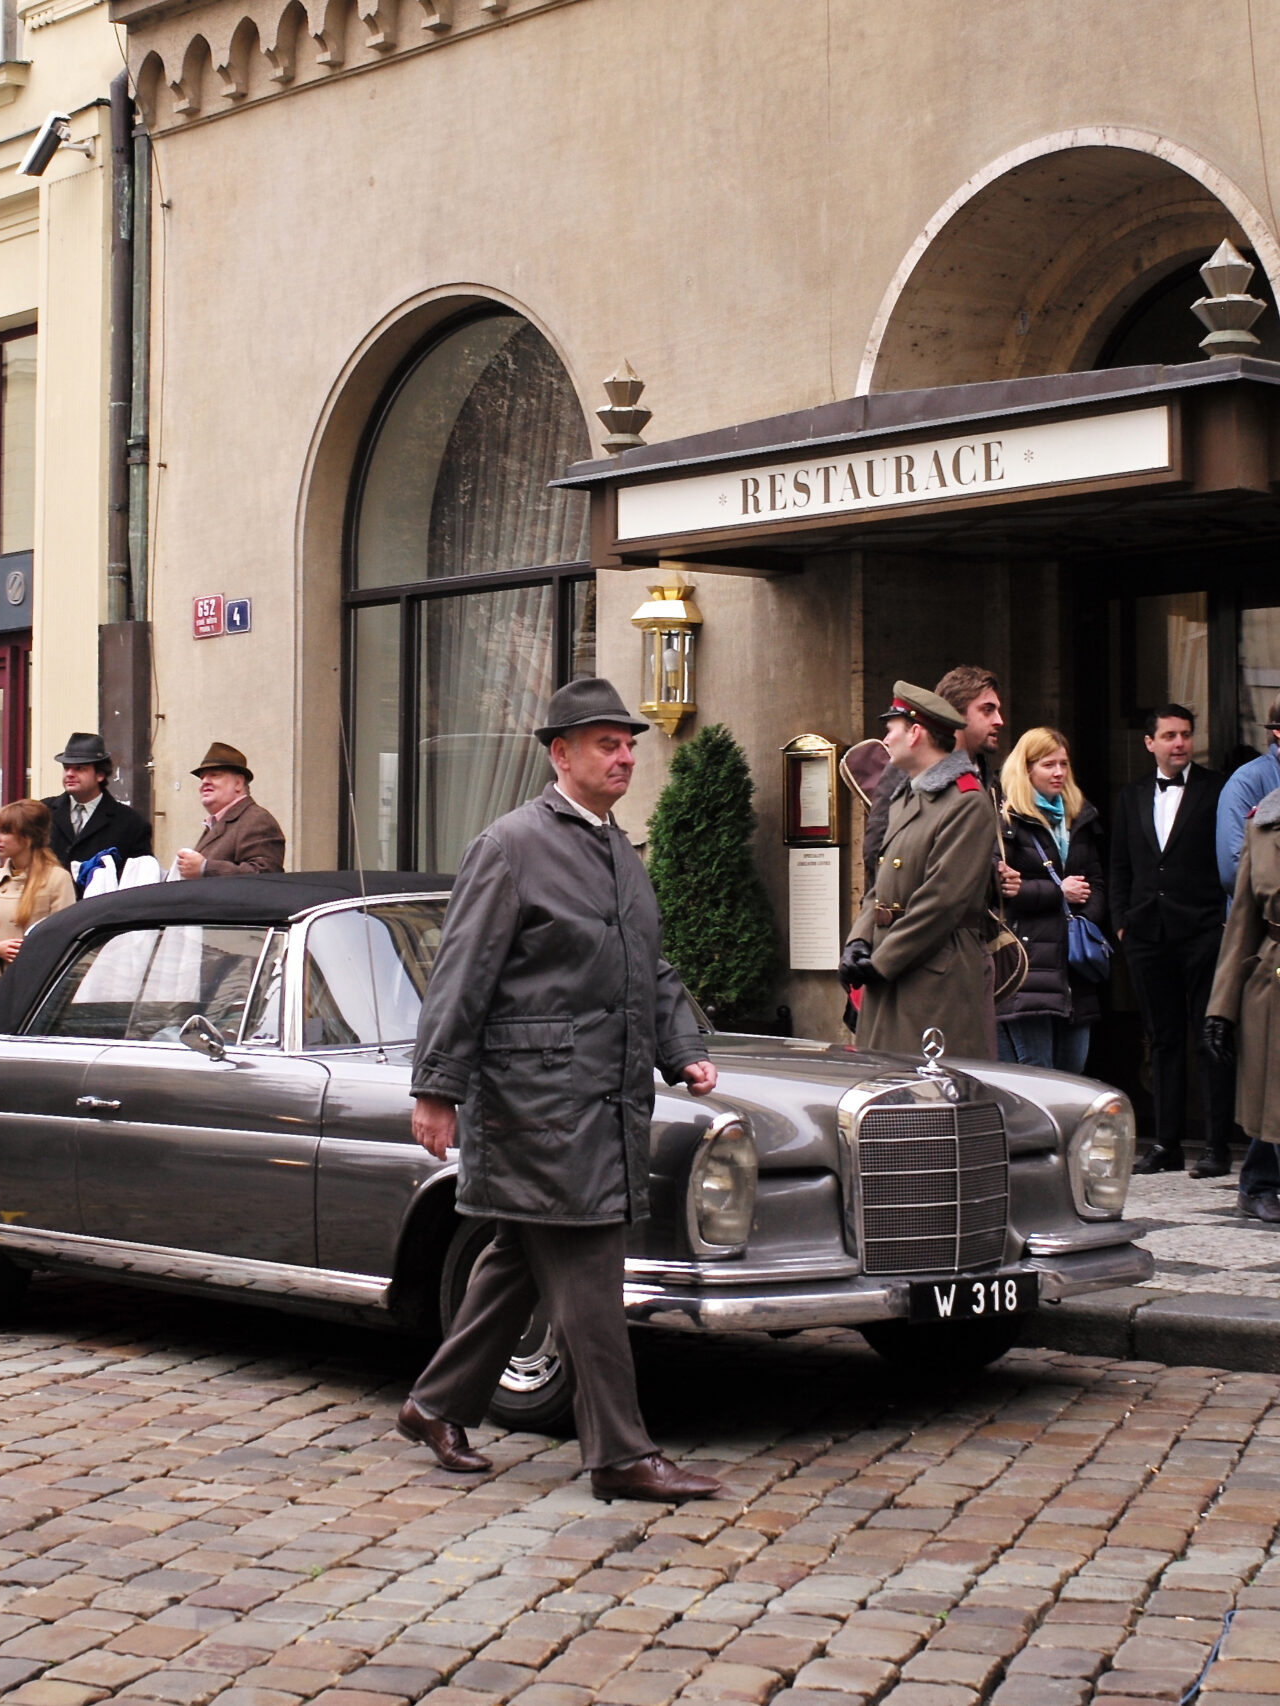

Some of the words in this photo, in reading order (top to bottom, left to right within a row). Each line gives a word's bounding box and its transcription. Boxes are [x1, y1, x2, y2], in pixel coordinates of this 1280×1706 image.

[740, 440, 1005, 515] RESTAURACE
[197, 599, 216, 617] 652
[233, 607, 240, 626] 4
[933, 1283, 956, 1318] W
[972, 1280, 1017, 1314] 318
